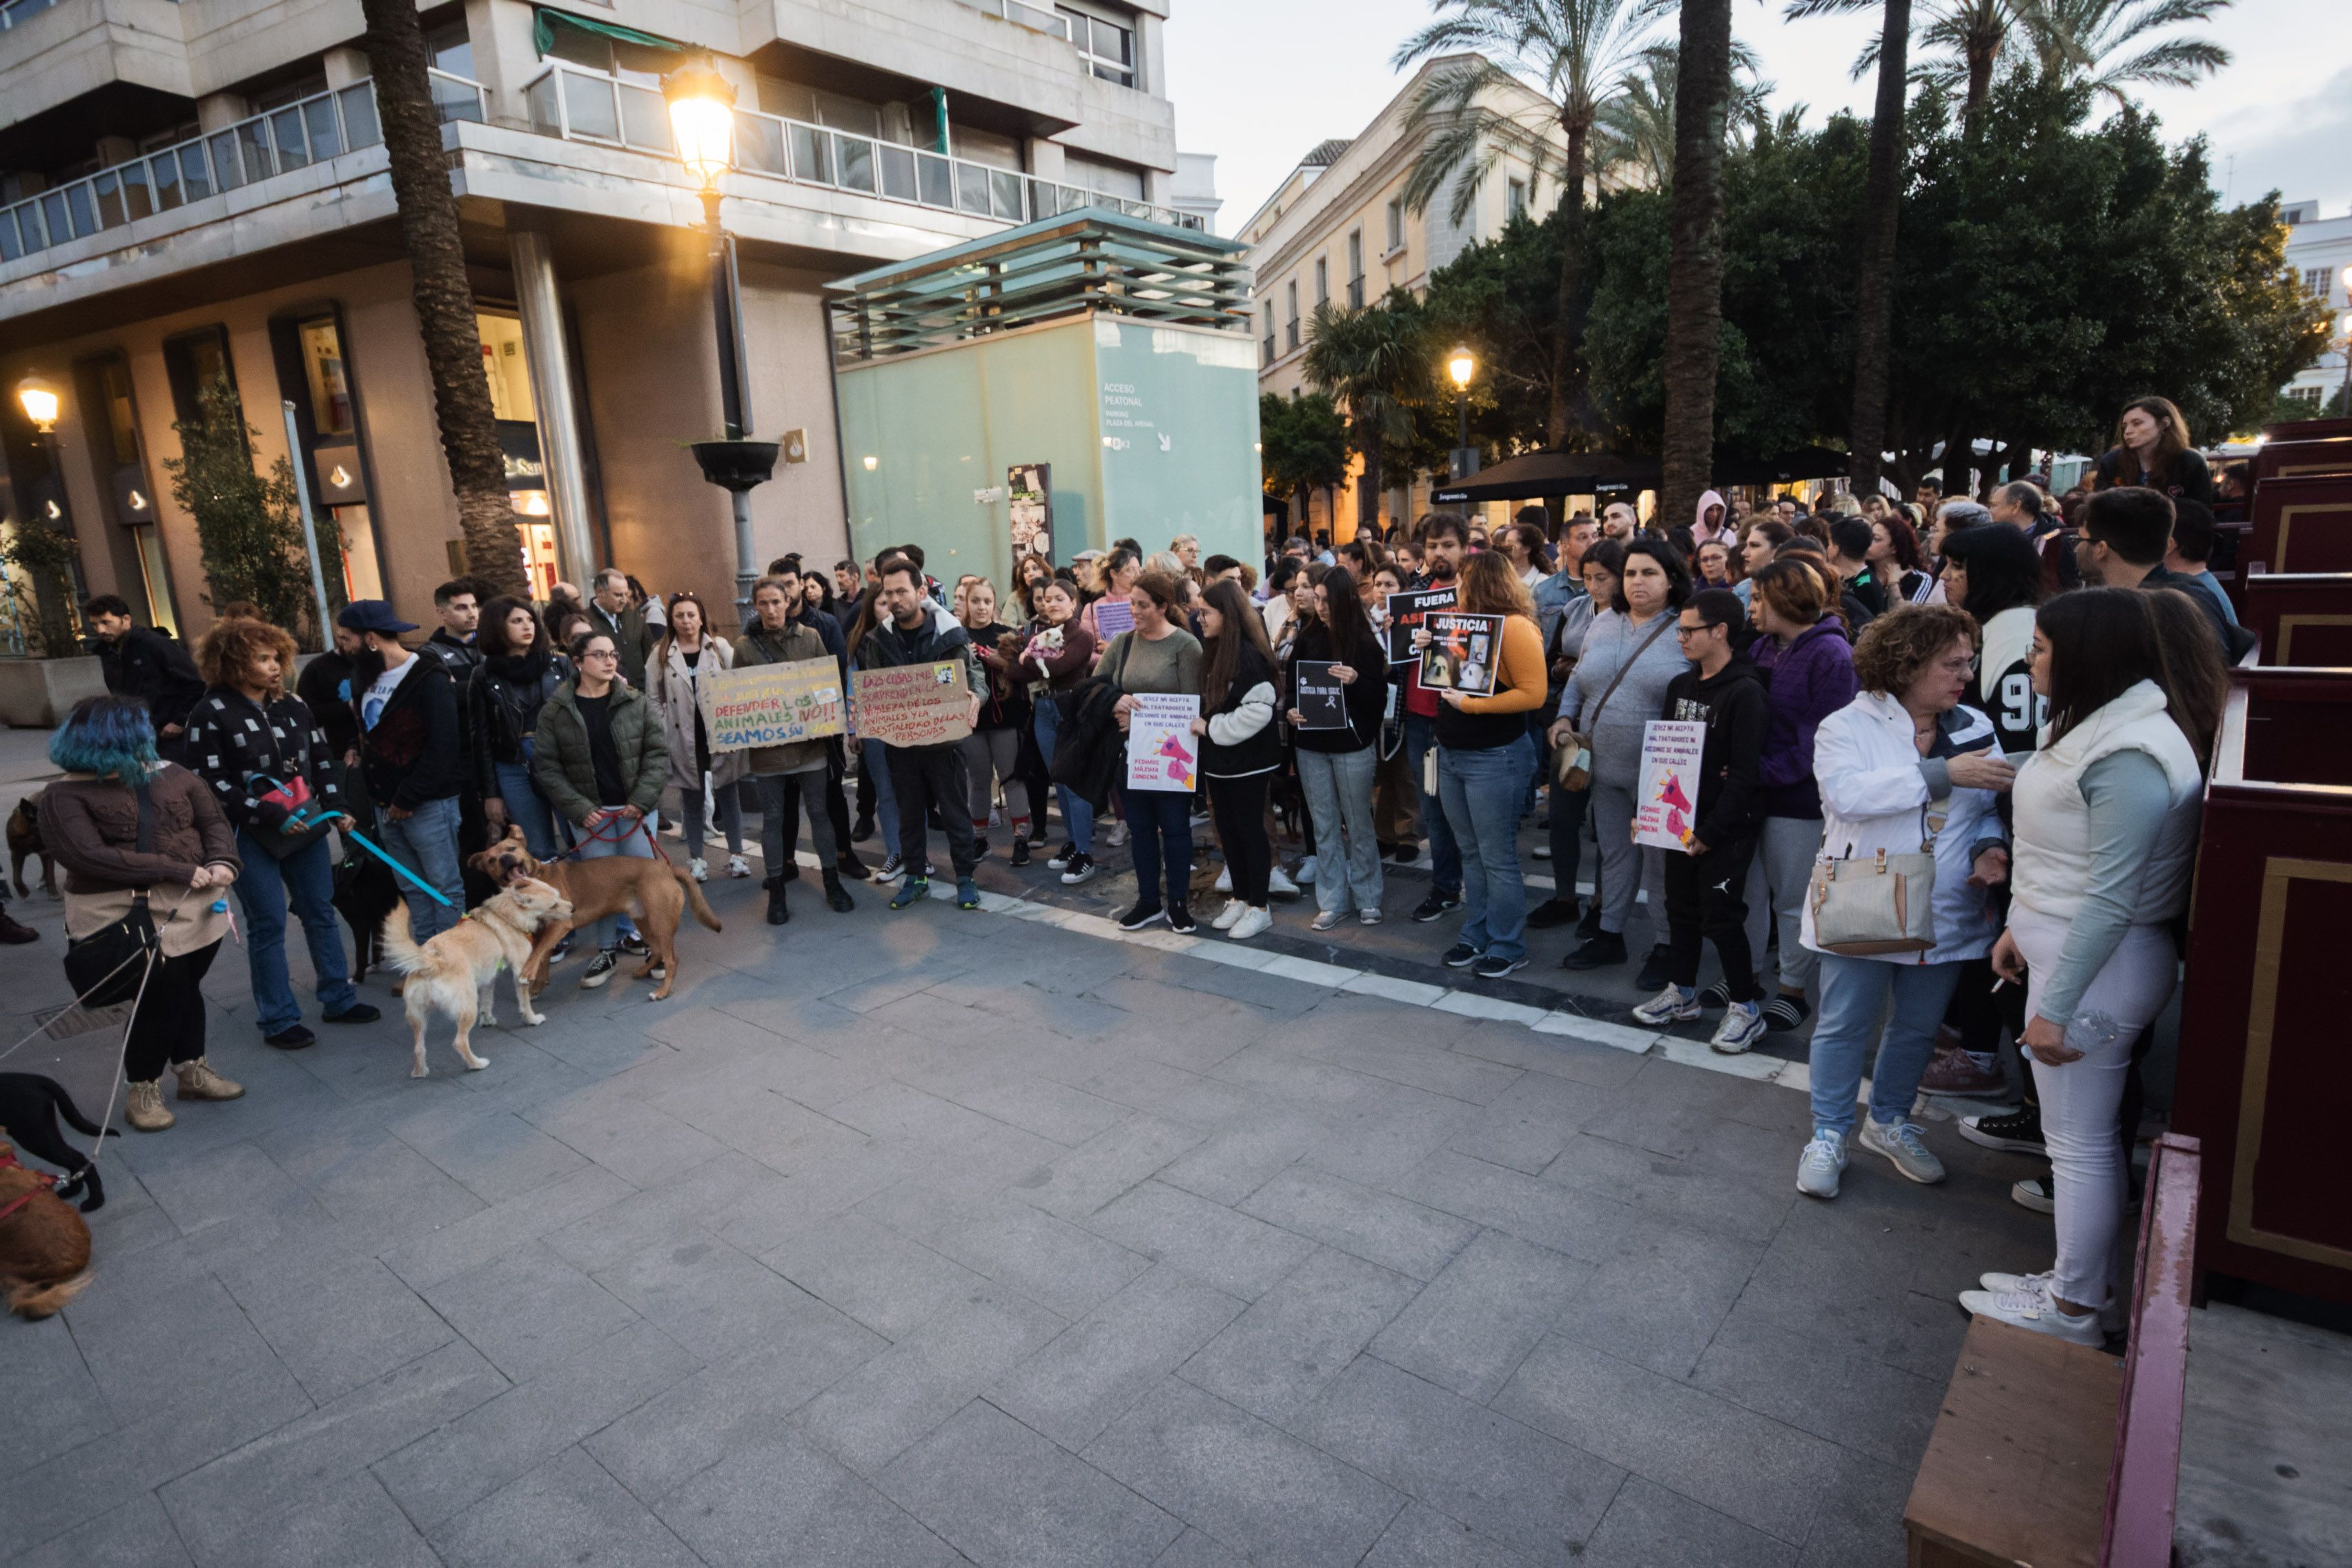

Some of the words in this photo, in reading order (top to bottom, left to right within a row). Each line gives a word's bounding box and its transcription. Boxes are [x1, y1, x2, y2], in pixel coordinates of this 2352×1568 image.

[1104, 382, 1135, 393] ACCESO
[1105, 396, 1143, 407] PEATONAL
[1414, 592, 1455, 608] FUERA
[1300, 686, 1316, 695] JUSTICIA
[1317, 686, 1328, 695] PARA
[908, 699, 920, 710] DE
[923, 697, 941, 706] LOS
[715, 711, 793, 730] ANIMALES
[717, 726, 787, 745] SEAMOS
